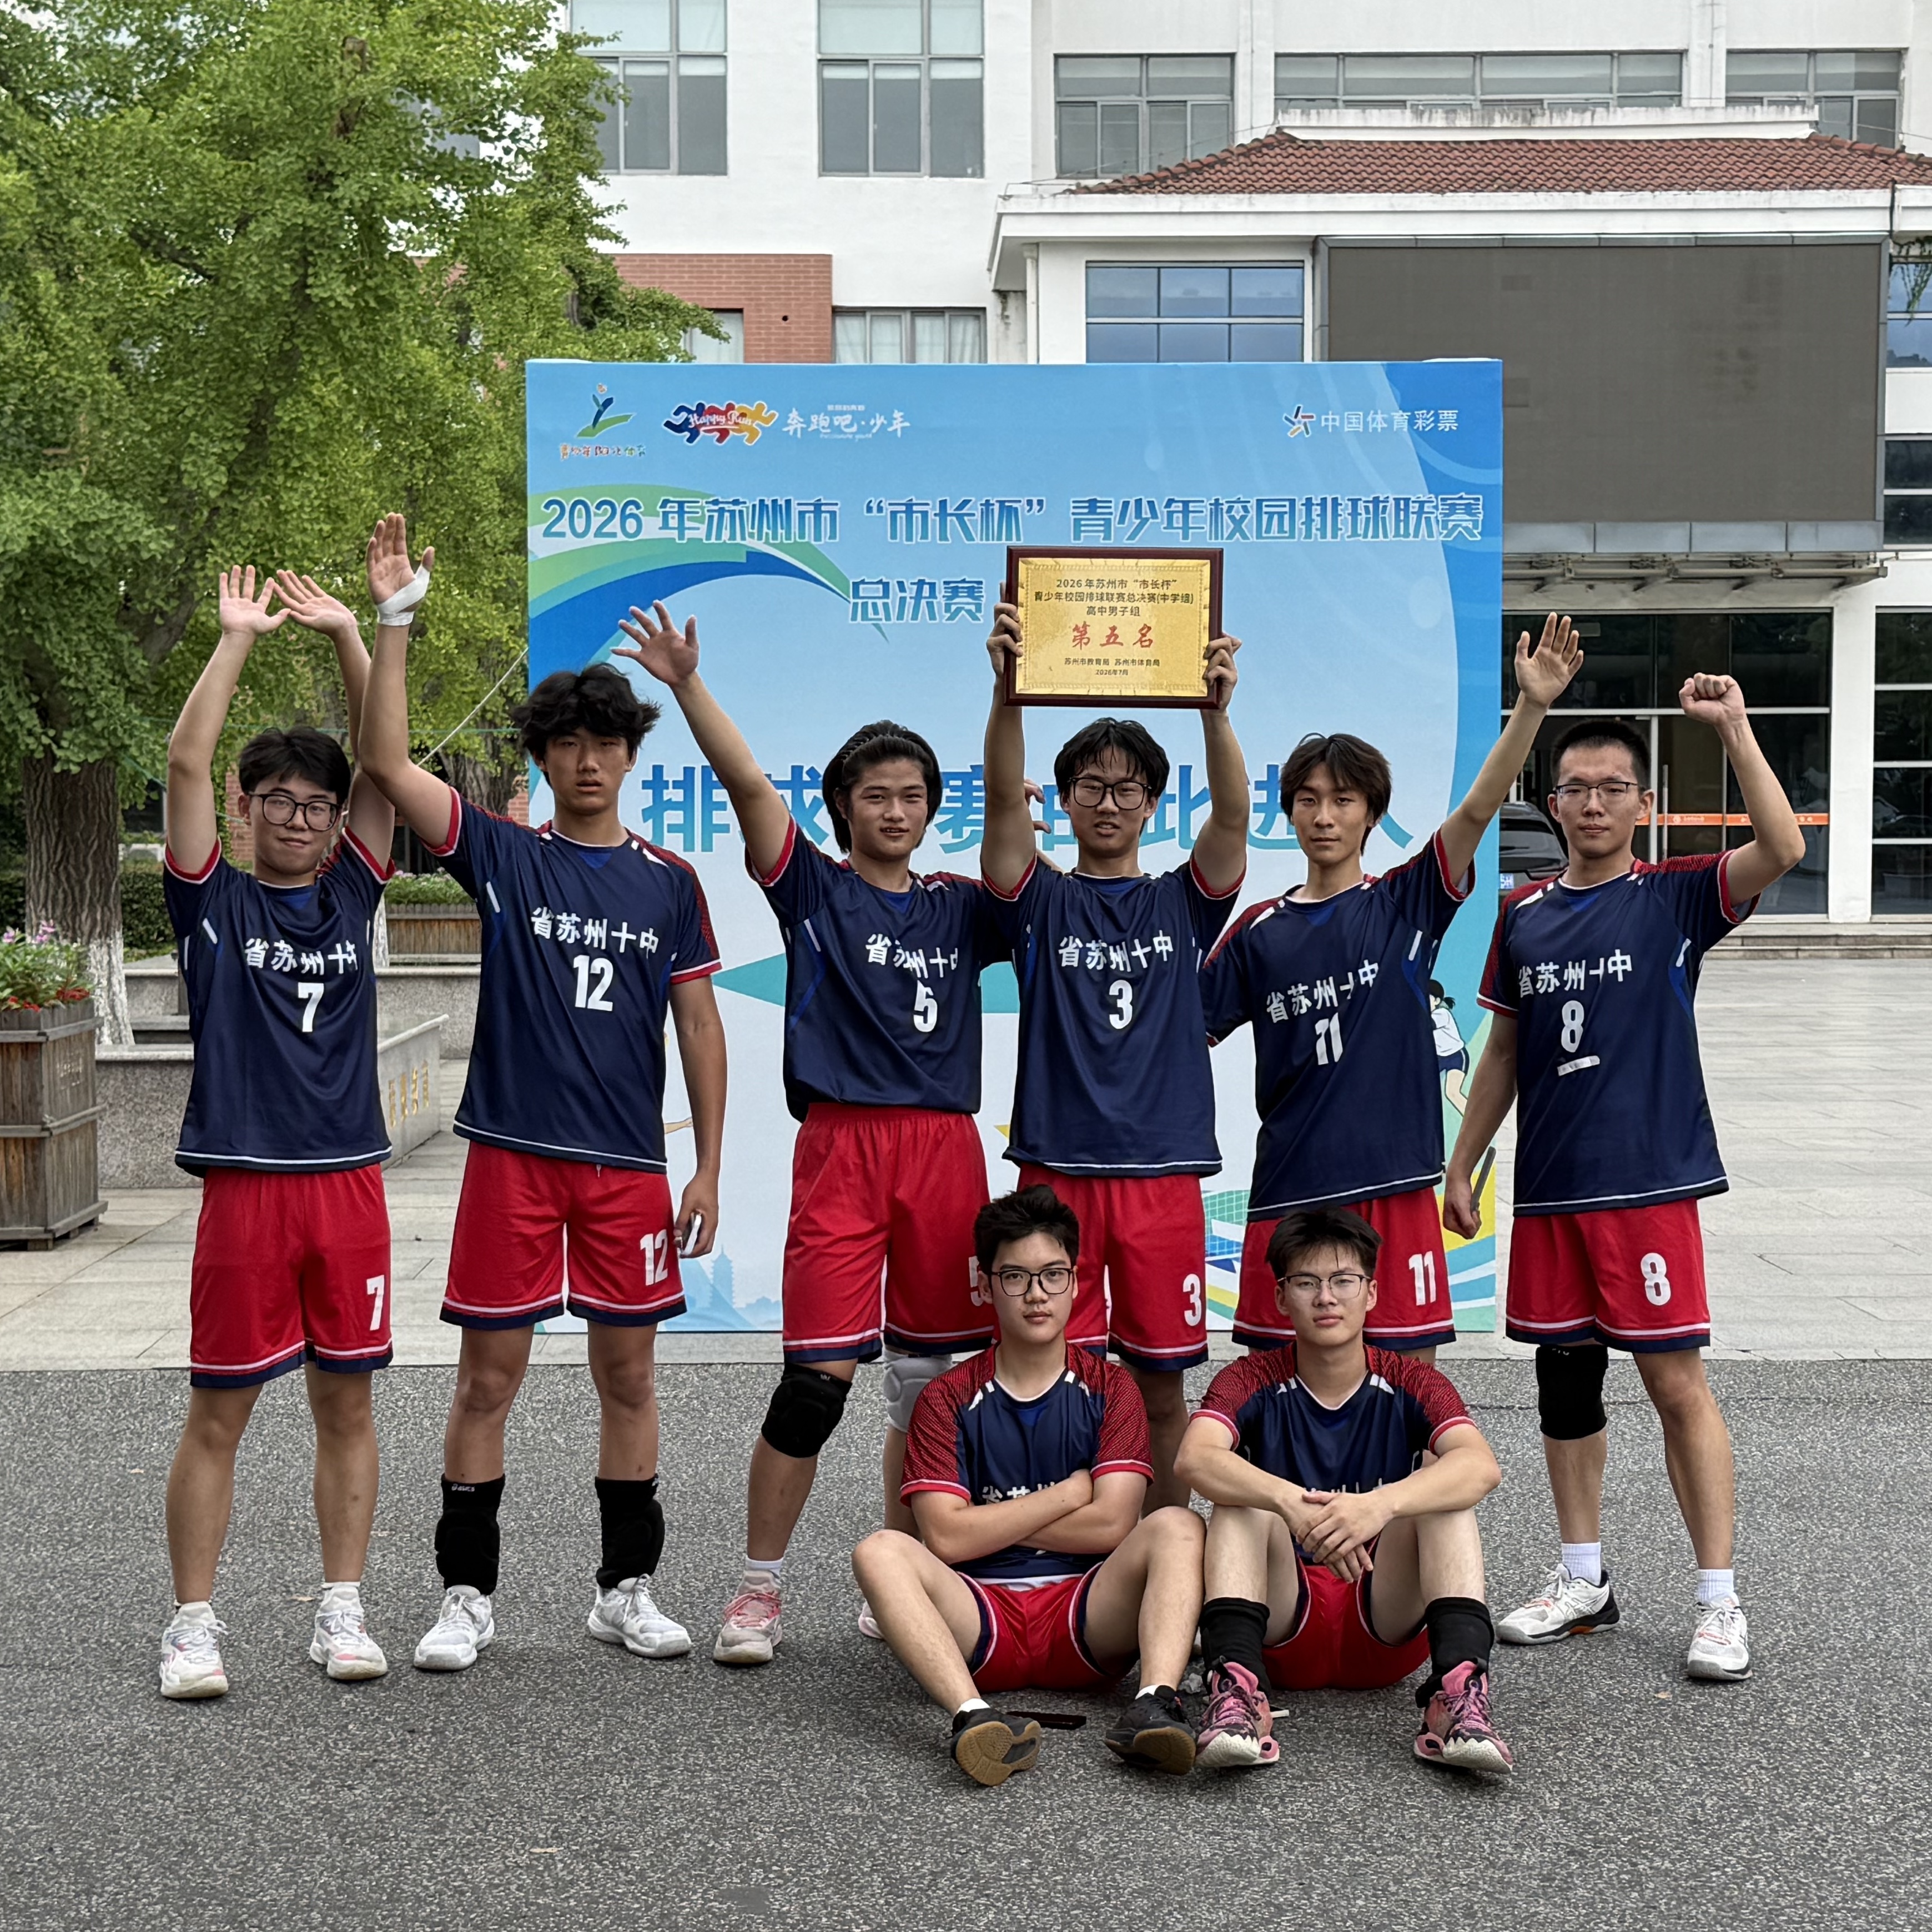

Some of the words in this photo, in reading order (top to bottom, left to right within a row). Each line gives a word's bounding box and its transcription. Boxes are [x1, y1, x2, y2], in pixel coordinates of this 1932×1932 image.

[688, 412, 726, 428] Happy
[727, 410, 752, 425] Run
[1321, 410, 1458, 432] 中国体育彩票
[849, 578, 984, 622] 总决赛
[1086, 606, 1140, 616] 高中男子组
[1072, 621, 1153, 650] 第五名
[1064, 657, 1110, 666] 苏州市教育局
[531, 907, 659, 955] 省苏州十中
[1059, 930, 1174, 972] 省苏州十中
[298, 982, 324, 1033] 7
[573, 954, 613, 1012] 12
[913, 980, 938, 1033] 5
[1109, 979, 1133, 1029] 3
[1315, 1012, 1343, 1065] 11
[1561, 1000, 1584, 1053] 8
[640, 1229, 668, 1286] 12
[1408, 1251, 1436, 1306] 11
[1641, 1252, 1671, 1306] 8
[366, 1275, 385, 1331] 7
[1183, 1274, 1202, 1326] 3
